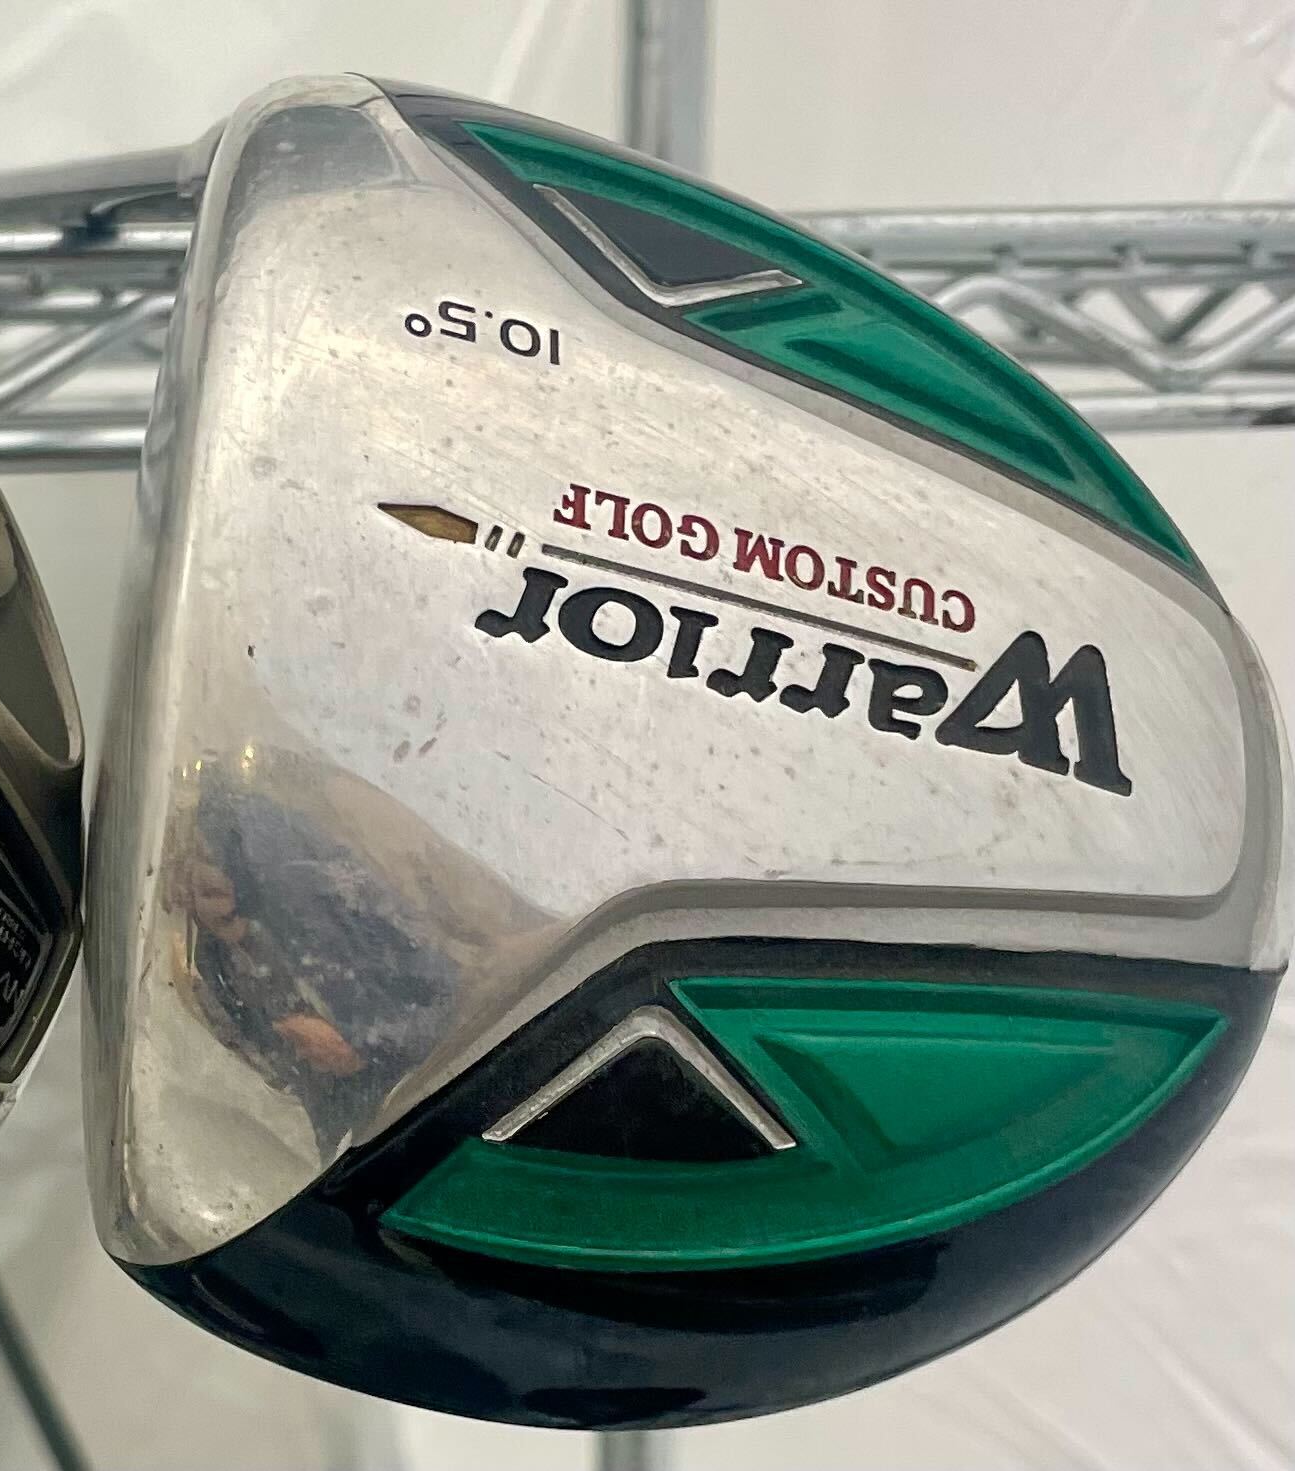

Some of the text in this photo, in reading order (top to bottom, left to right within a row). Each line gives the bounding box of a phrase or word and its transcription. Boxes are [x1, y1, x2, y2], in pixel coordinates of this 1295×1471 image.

[405, 300, 561, 365] 10.5°
[553, 483, 976, 633] CUSTOM GOLF
[475, 566, 1133, 798] Warrior
